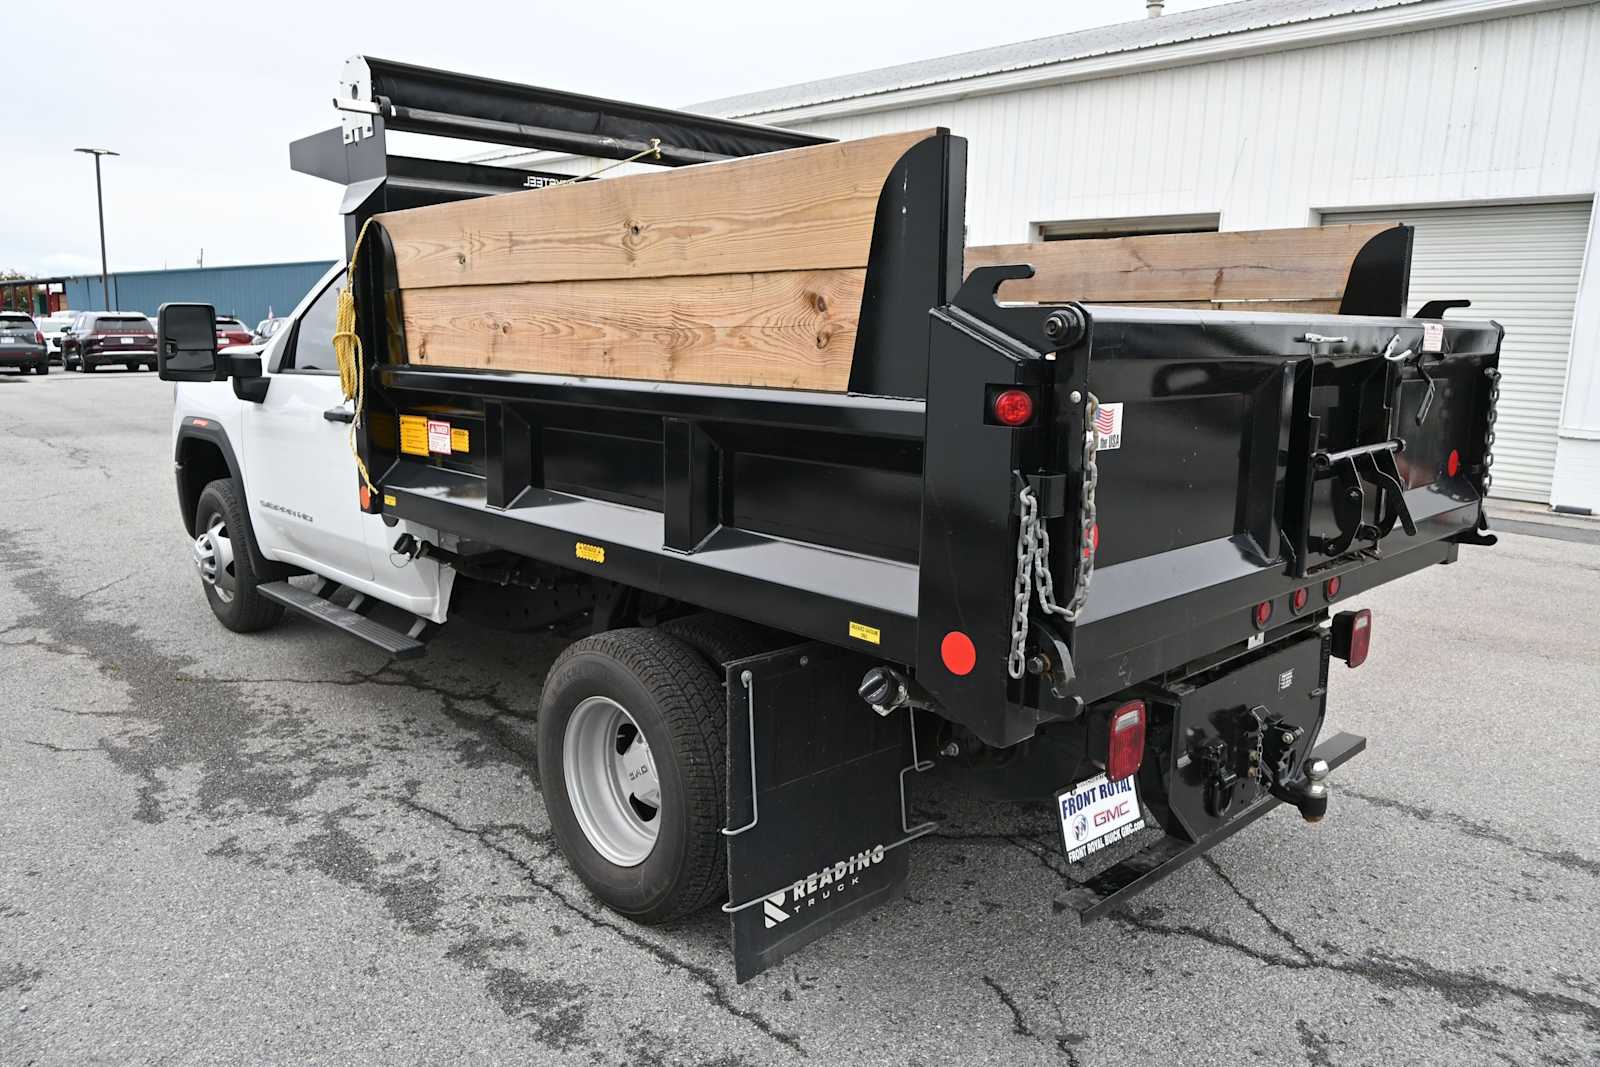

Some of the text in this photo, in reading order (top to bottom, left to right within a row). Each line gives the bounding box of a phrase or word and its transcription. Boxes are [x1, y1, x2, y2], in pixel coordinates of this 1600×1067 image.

[1109, 434, 1119, 448] USA
[1062, 787, 1096, 820] FRONT
[1099, 777, 1131, 799] ROYAL
[1094, 801, 1130, 827] GMC
[1068, 844, 1087, 864] FRONT
[1086, 837, 1105, 854] ROYAL
[1104, 828, 1122, 846] BUICK
[793, 844, 884, 901] READING
[794, 876, 859, 913] TRUCK
